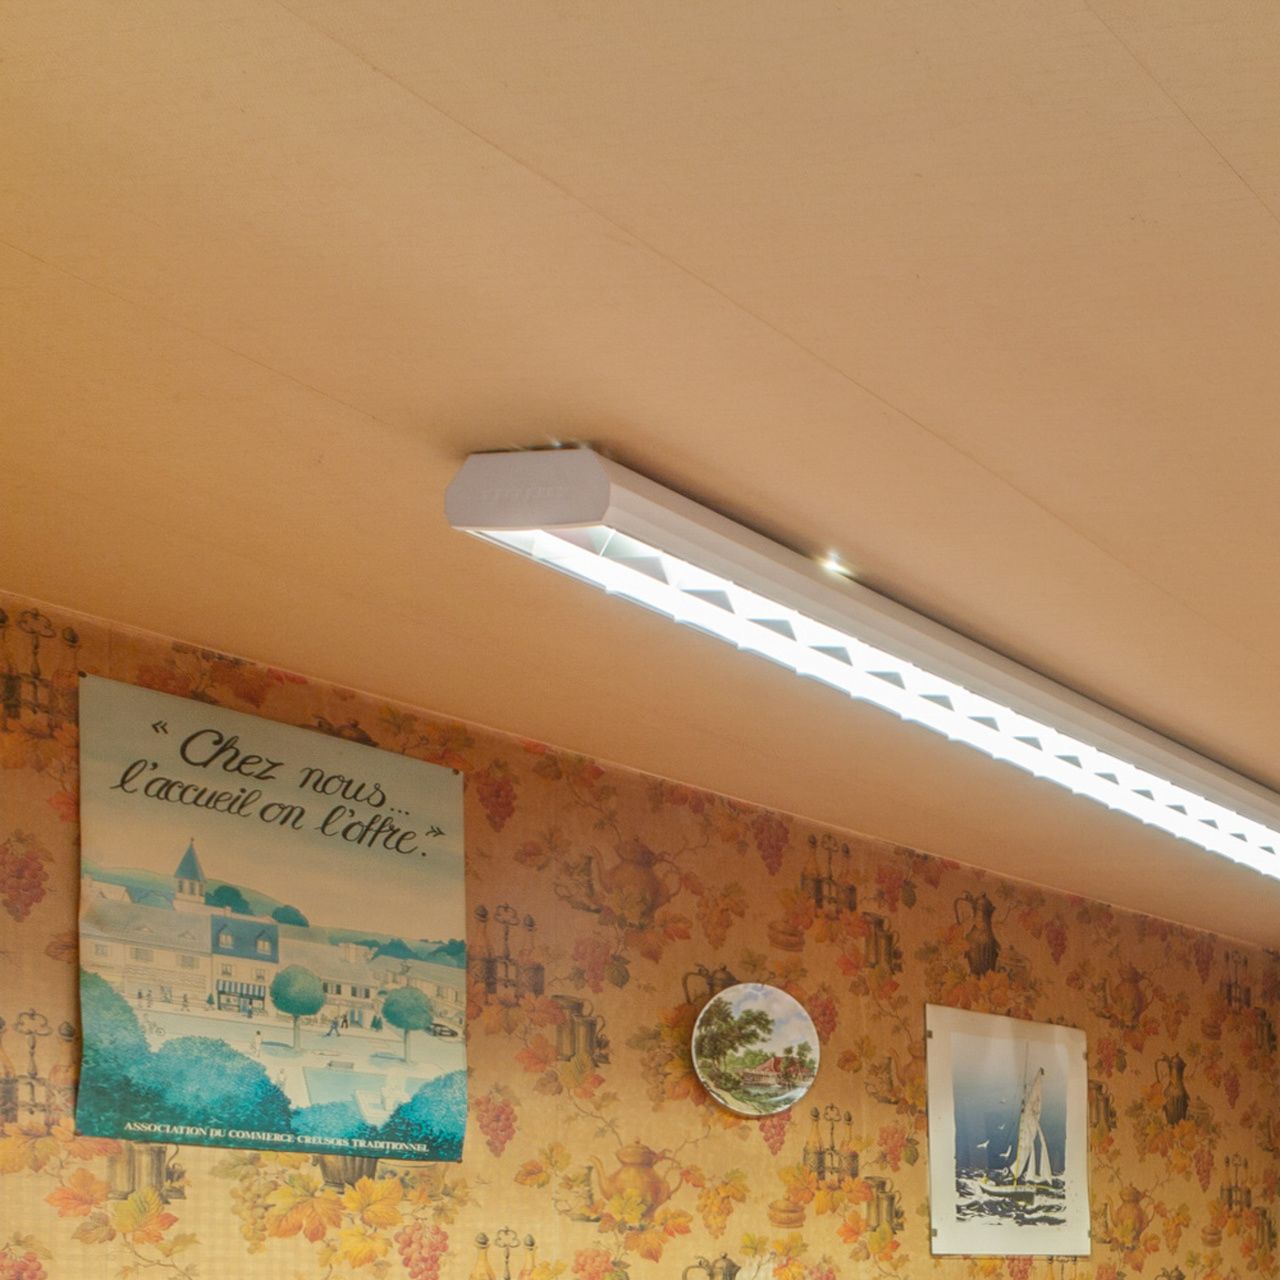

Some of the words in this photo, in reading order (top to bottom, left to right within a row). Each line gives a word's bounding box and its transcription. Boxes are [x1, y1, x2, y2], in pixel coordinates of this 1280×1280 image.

[180, 728, 285, 781] Chez
[110, 758, 263, 819] l'accueil
[260, 803, 306, 831] on
[124, 1121, 207, 1137] ASSOCIATION
[209, 1128, 226, 1139] DU
[228, 1129, 294, 1143] COMMERCE
[351, 1138, 430, 1153] TRADITIONNEL
